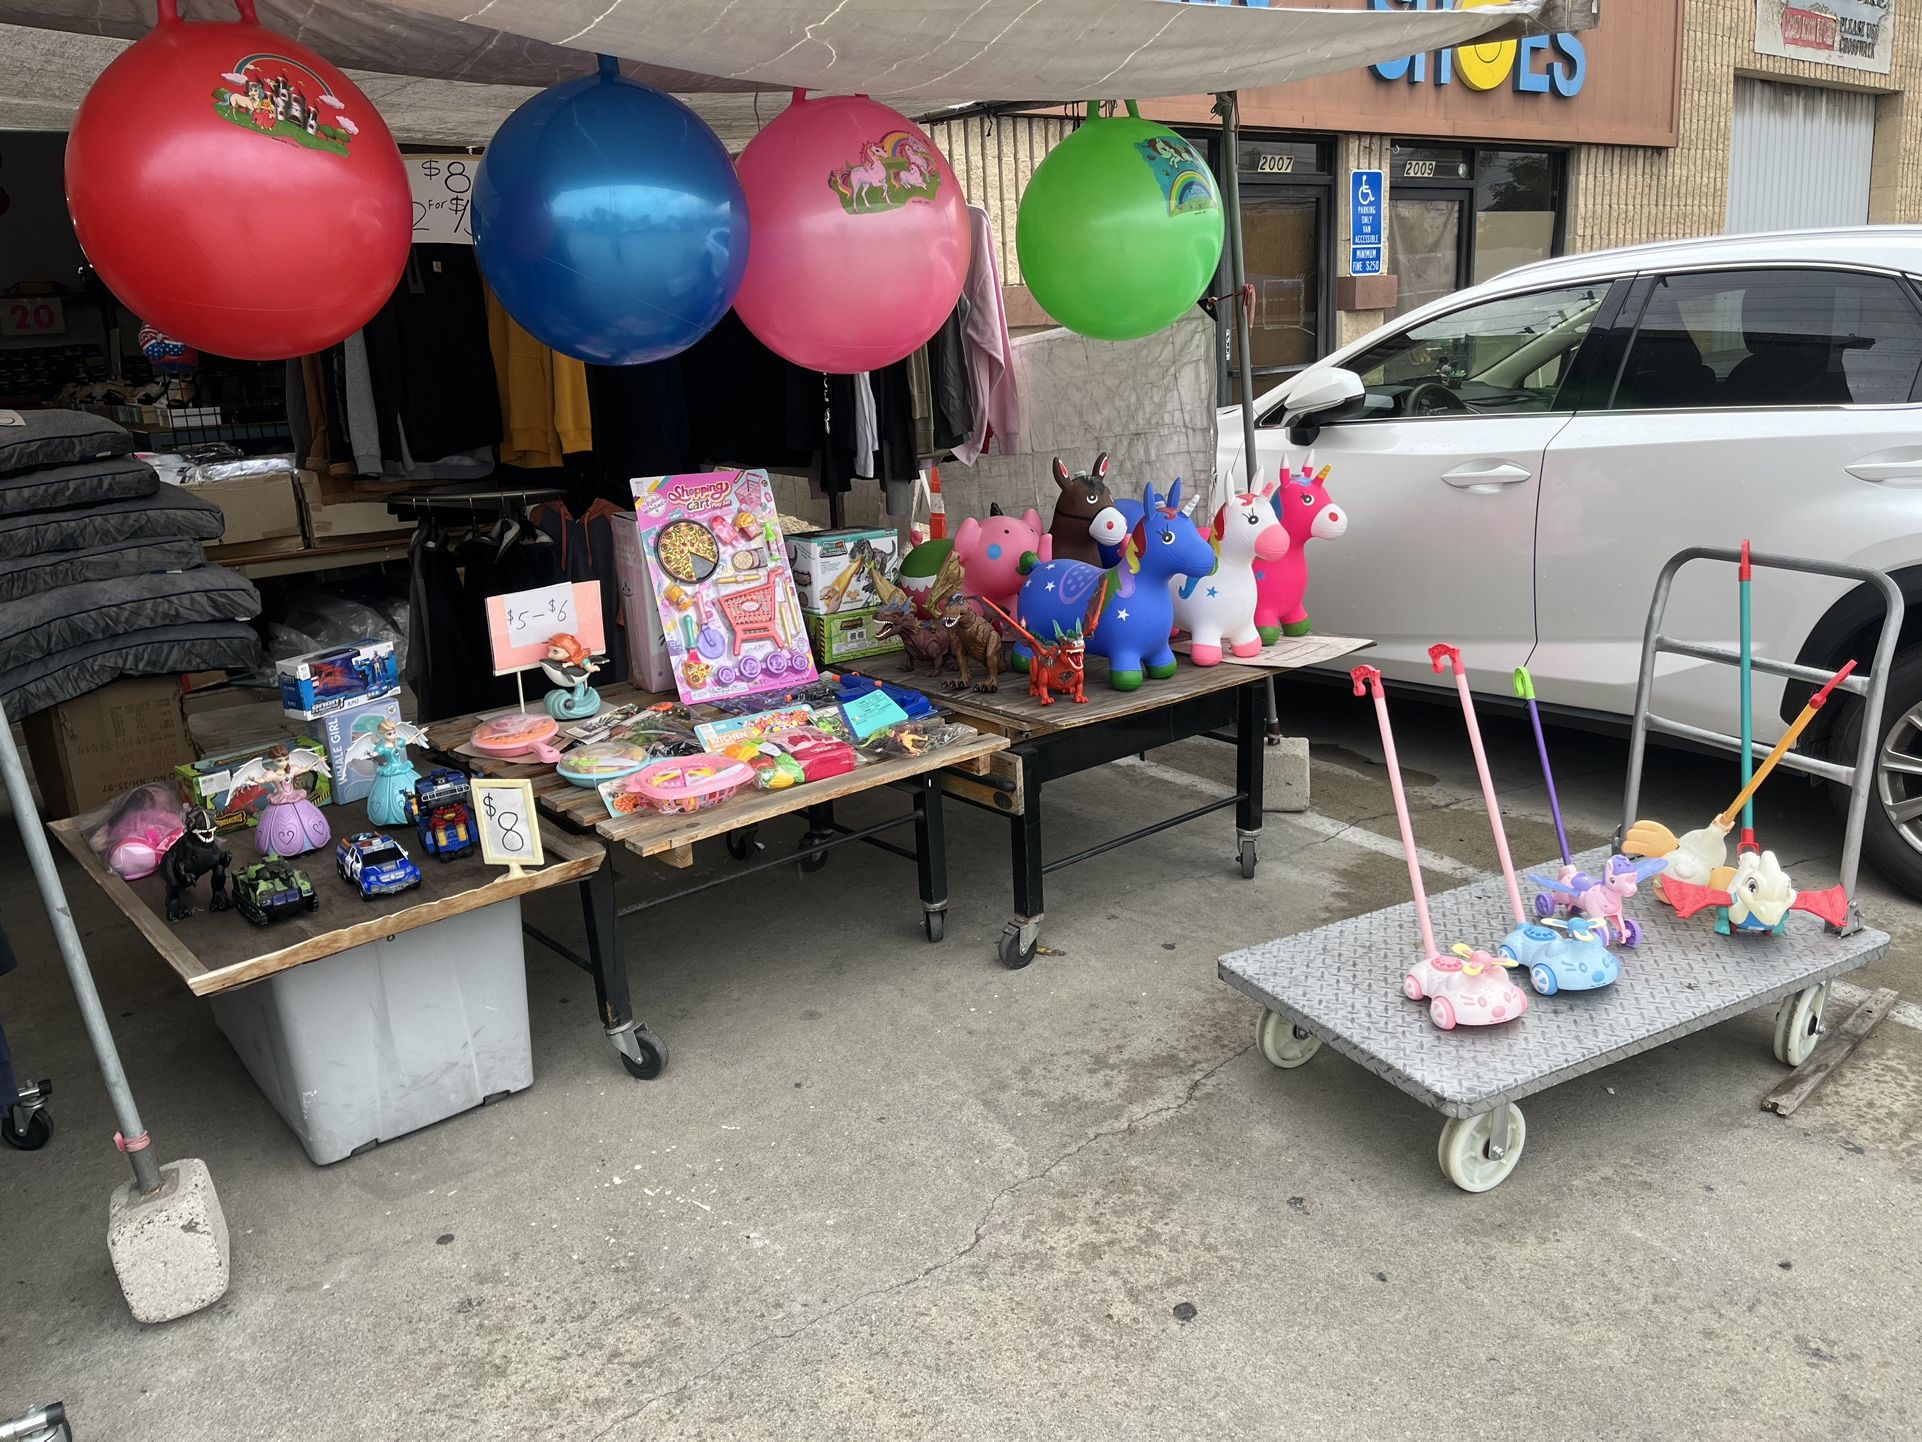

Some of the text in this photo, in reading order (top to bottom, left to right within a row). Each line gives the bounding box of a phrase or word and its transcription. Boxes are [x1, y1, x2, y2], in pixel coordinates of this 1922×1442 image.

[1260, 157, 1294, 171] 2007
[1406, 162, 1433, 176] 2009
[422, 158, 471, 193] $8
[428, 199, 448, 210] For
[449, 196, 473, 236] $1
[1358, 206, 1376, 214] PARKING
[1361, 216, 1373, 224] ONLY
[1355, 235, 1379, 243] ACCESSIBLE
[1356, 249, 1377, 259] MINIMUM
[1353, 260, 1379, 271] FINE $250
[10, 304, 55, 329] 20
[667, 481, 731, 501] Shopping
[507, 609, 529, 630] $5
[548, 598, 568, 622] $6
[328, 718, 341, 743] GIRL
[710, 731, 747, 745] KITCHEN
[483, 793, 524, 852] $8
